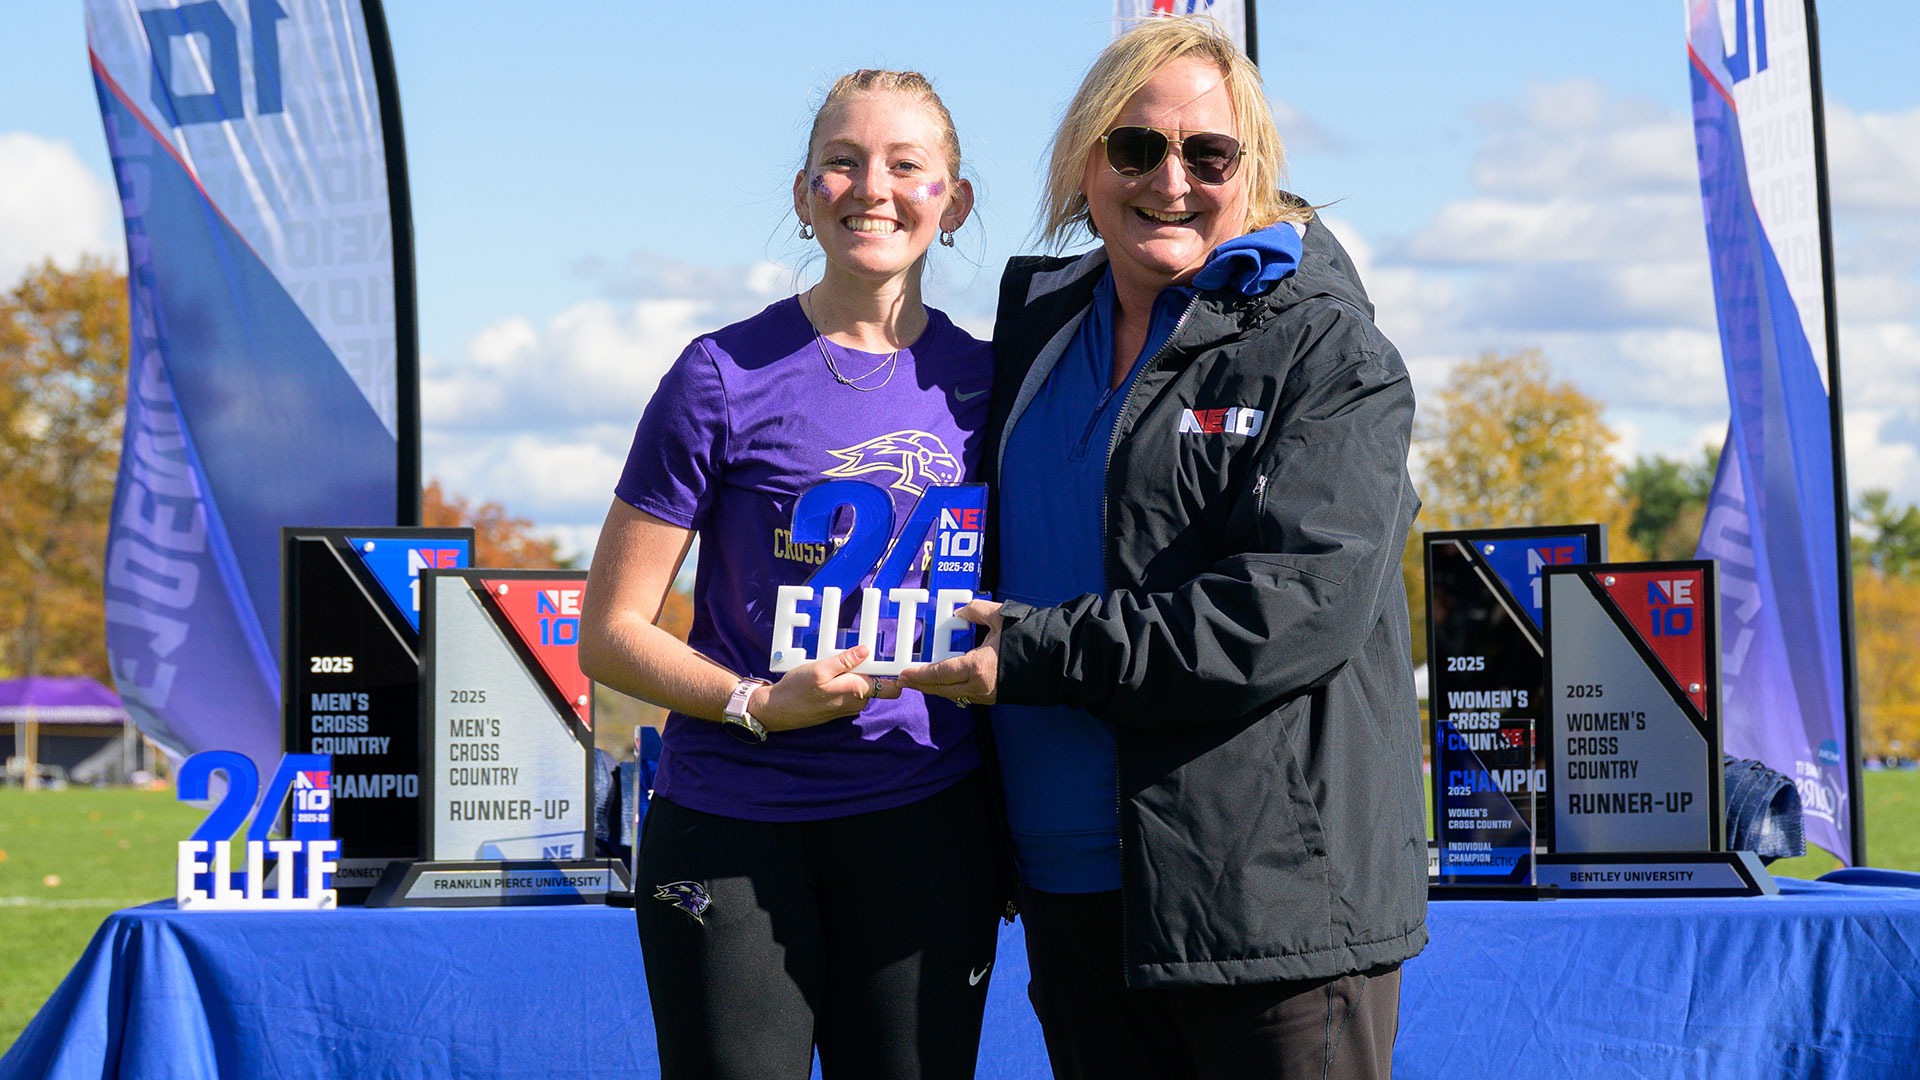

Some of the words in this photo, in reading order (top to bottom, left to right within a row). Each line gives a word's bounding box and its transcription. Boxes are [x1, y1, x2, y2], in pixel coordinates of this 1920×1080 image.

[940, 508, 980, 529] NE
[774, 528, 835, 566] CROSS
[939, 532, 978, 557] 10
[937, 562, 975, 572] 2025-26
[1648, 580, 1694, 604] NE
[538, 590, 581, 614] NE
[538, 617, 579, 645] 10
[770, 586, 973, 676] ELITE
[1650, 608, 1693, 636] 10
[311, 657, 353, 673] 2025
[1447, 657, 1485, 671] 2025
[450, 691, 486, 703] 2025
[1447, 689, 1529, 709] WOMEN'S
[1567, 685, 1603, 698] 2025
[311, 693, 369, 711] MEN'S
[311, 715, 369, 733] CROSS
[450, 718, 500, 737] MEN'S
[1448, 712, 1500, 730] CROSS
[1567, 711, 1646, 732] WOMEN'S
[311, 737, 390, 755] COUNTRY
[450, 743, 500, 761] CROSS
[1567, 737, 1618, 755] CROSS
[450, 767, 519, 785] COUNTRY
[1568, 760, 1638, 780] COUNTRY
[296, 771, 330, 788] NE
[331, 775, 418, 798] HAMPIO
[1449, 769, 1546, 792] CHAMPIO
[297, 790, 330, 810] 10
[1448, 786, 1471, 796] 2025
[450, 799, 570, 821] RUNNER-UP
[1569, 792, 1693, 814] RUNNER-UP
[1448, 808, 1488, 818] WOMEN'S
[1448, 820, 1475, 829] CROSS
[1476, 820, 1512, 829] COUNTRY
[1448, 842, 1493, 851] INDIVIDUAL
[1449, 854, 1491, 862] CHAMPION
[178, 841, 337, 910] ELITE
[434, 878, 491, 889] FRANKLIN
[495, 877, 532, 888] PIERCE
[536, 876, 601, 887] UNIVERSITY
[1570, 872, 1621, 882] BENTLEY
[1624, 871, 1693, 881] UNIVERSITY
